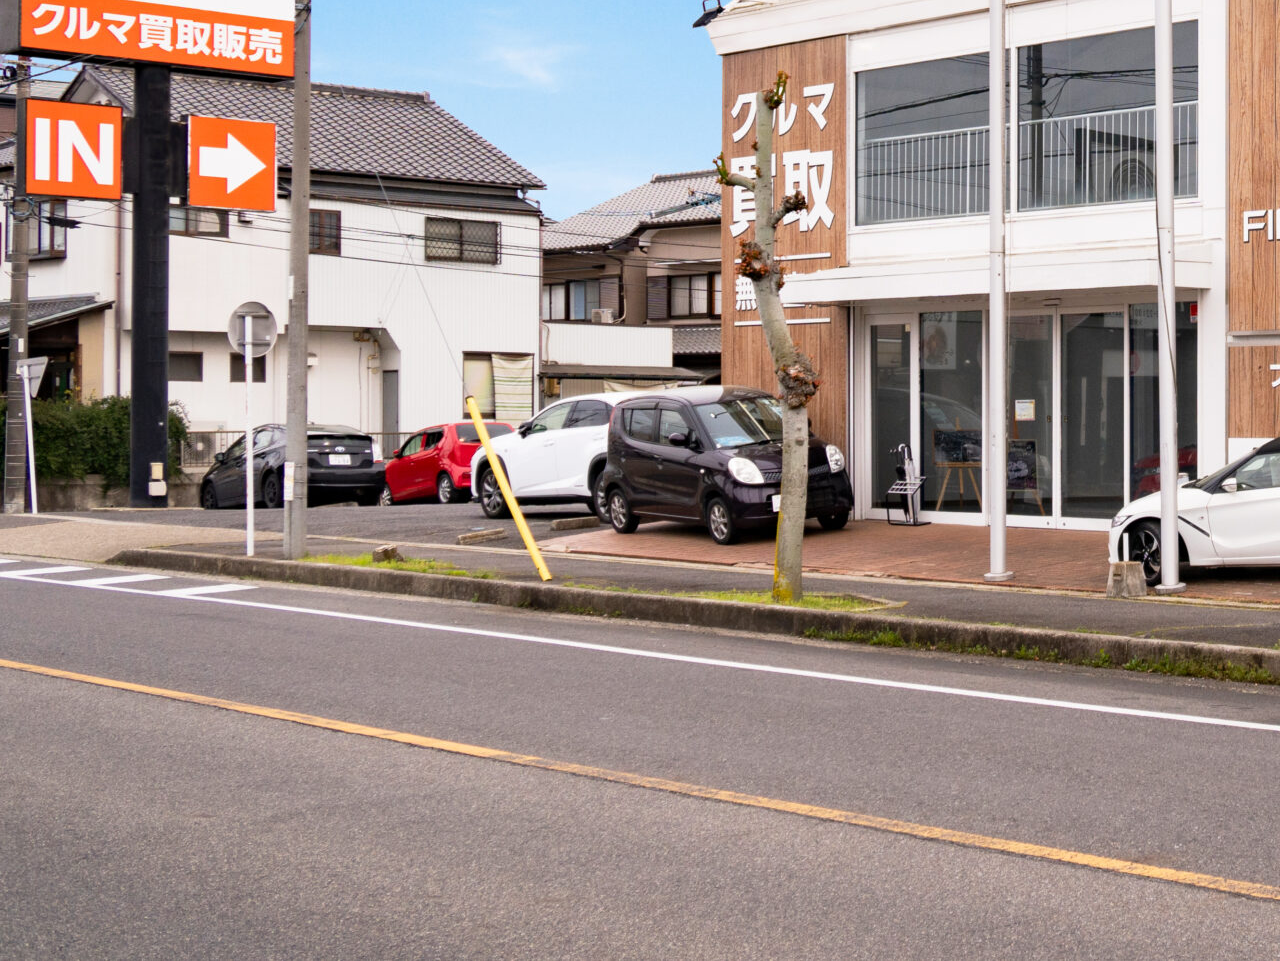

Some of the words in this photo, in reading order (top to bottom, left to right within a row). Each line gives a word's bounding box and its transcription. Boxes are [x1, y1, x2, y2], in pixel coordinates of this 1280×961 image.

[31, 3, 283, 65] クルマ買取販売
[34, 117, 115, 186] IN
